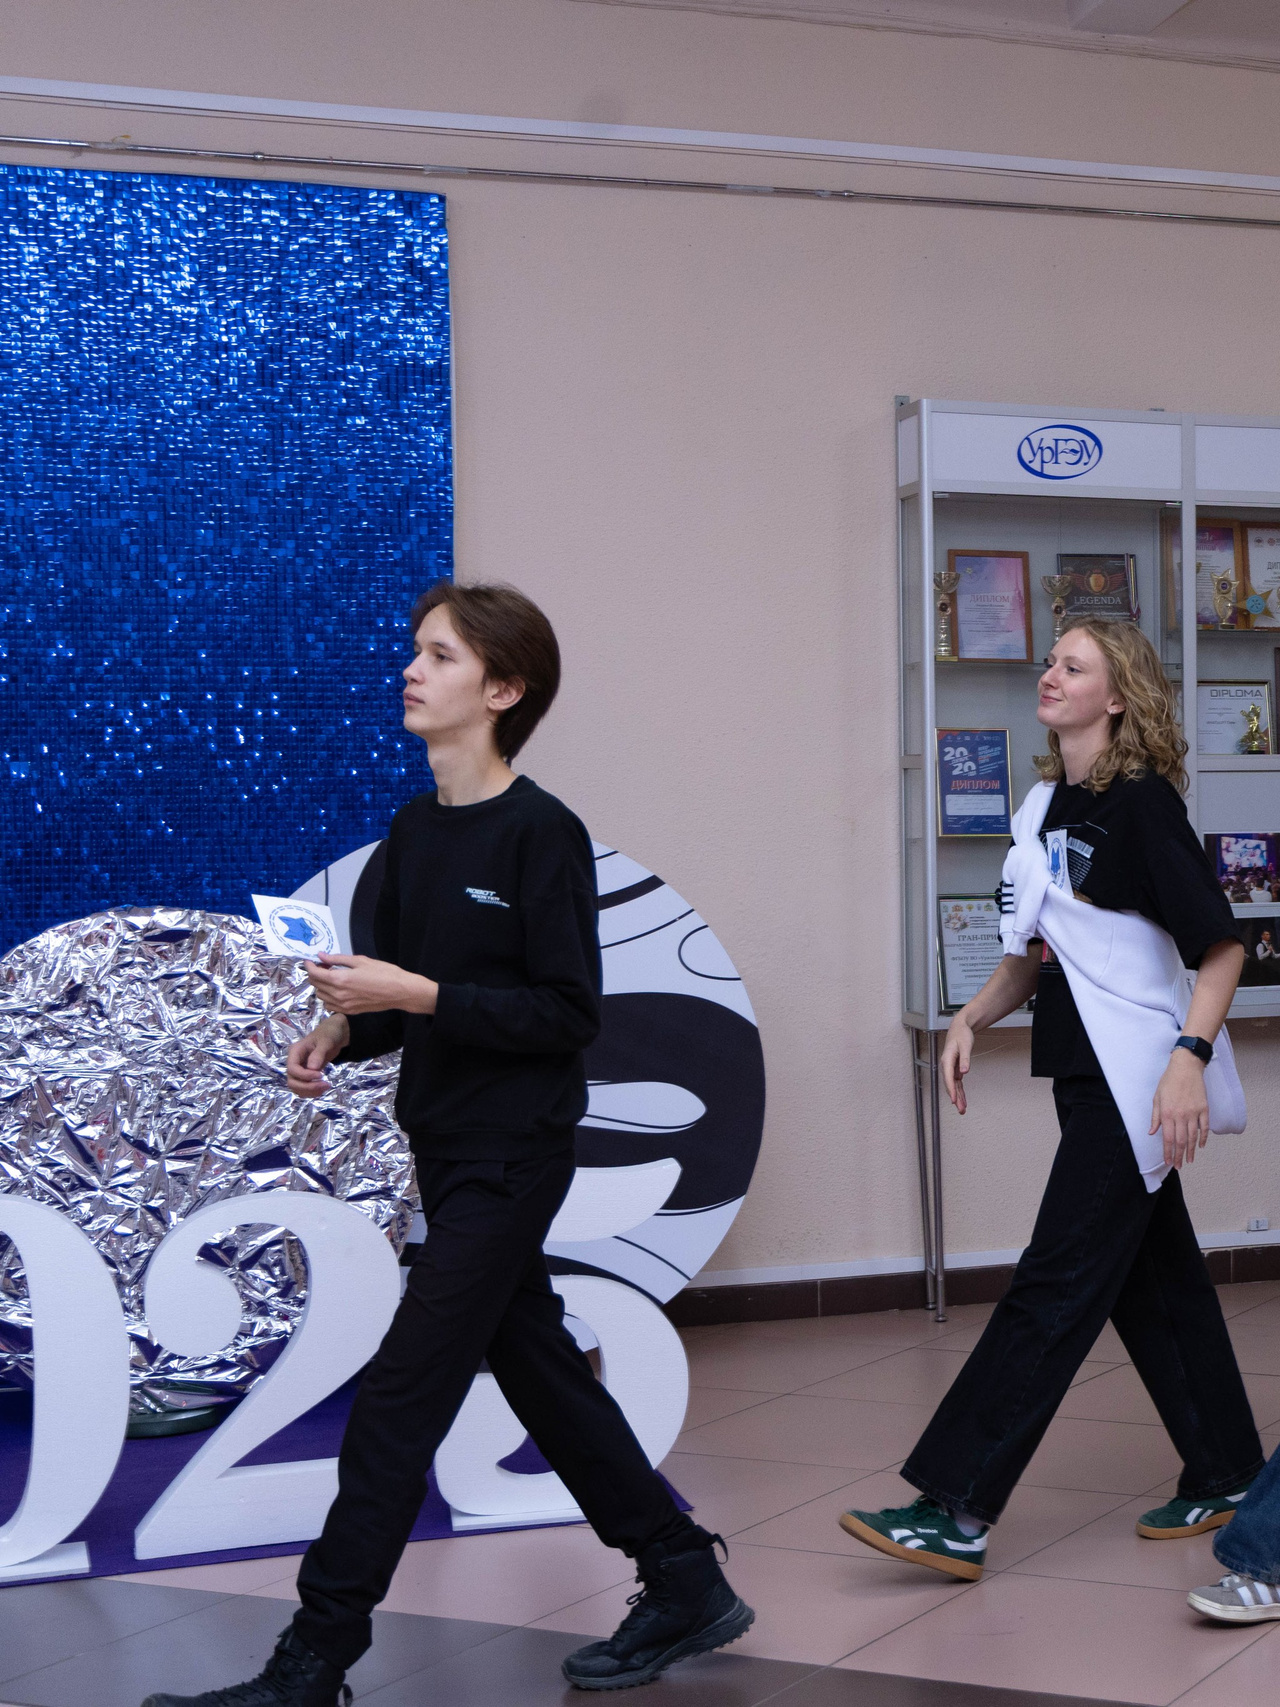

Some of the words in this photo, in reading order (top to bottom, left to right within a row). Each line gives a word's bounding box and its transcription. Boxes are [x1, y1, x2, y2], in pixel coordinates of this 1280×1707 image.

[1025, 437, 1097, 473] УрГЭУ
[970, 594, 1010, 603] ДИПЛОМ
[1073, 596, 1122, 605] LEGENDA
[1210, 689, 1263, 698] DIPLOMA
[943, 746, 968, 761] 20
[952, 761, 976, 775] 20
[951, 780, 1000, 790] ДИПЛОМ
[957, 934, 997, 942] ГРАН-ПРИ
